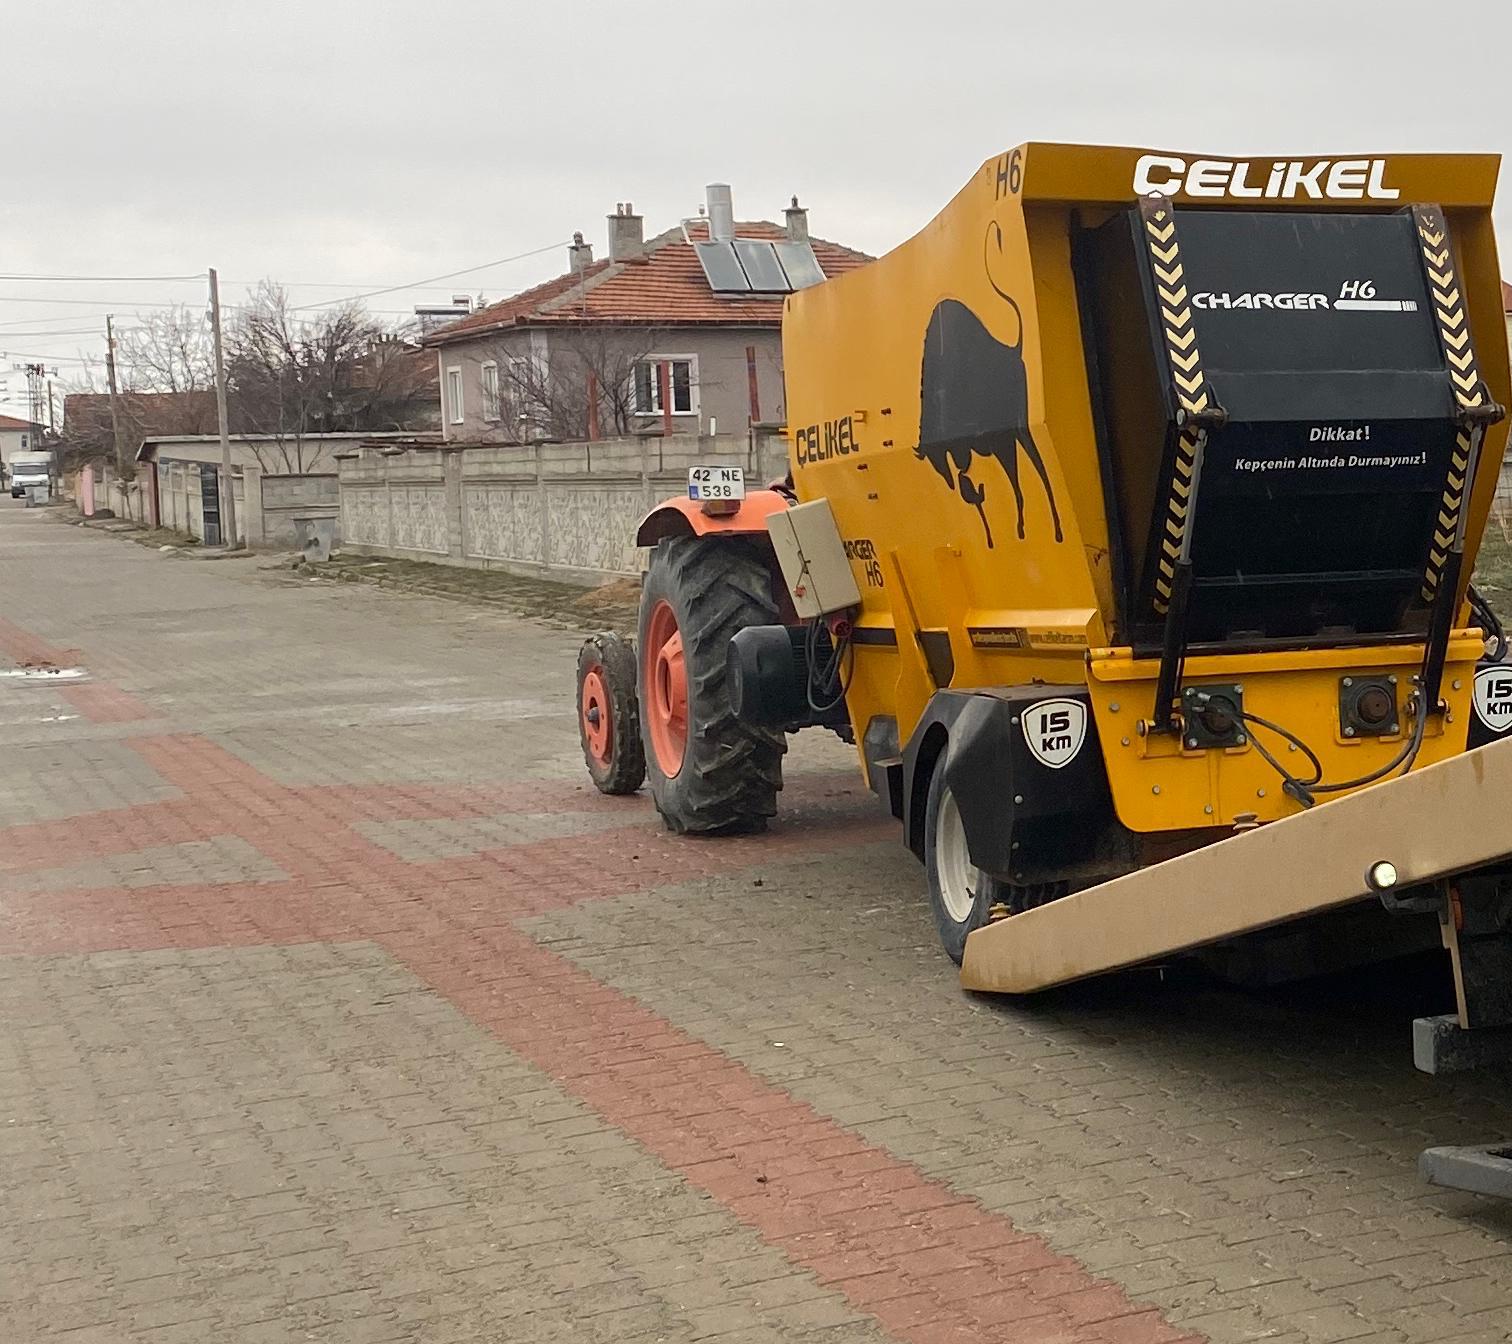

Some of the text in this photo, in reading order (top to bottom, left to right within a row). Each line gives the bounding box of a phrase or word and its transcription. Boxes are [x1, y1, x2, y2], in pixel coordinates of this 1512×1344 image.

[996, 150, 1021, 201] H6
[1191, 280, 1376, 310] CHARGER H6
[1310, 426, 1370, 442] Dikkat!
[1235, 451, 1427, 472] Kepçenin Altında Durmayınız!
[692, 470, 741, 482] 42 NE
[702, 486, 732, 498] 538
[864, 560, 884, 588] H6
[1487, 679, 1512, 698] 15
[1041, 711, 1069, 734] 15
